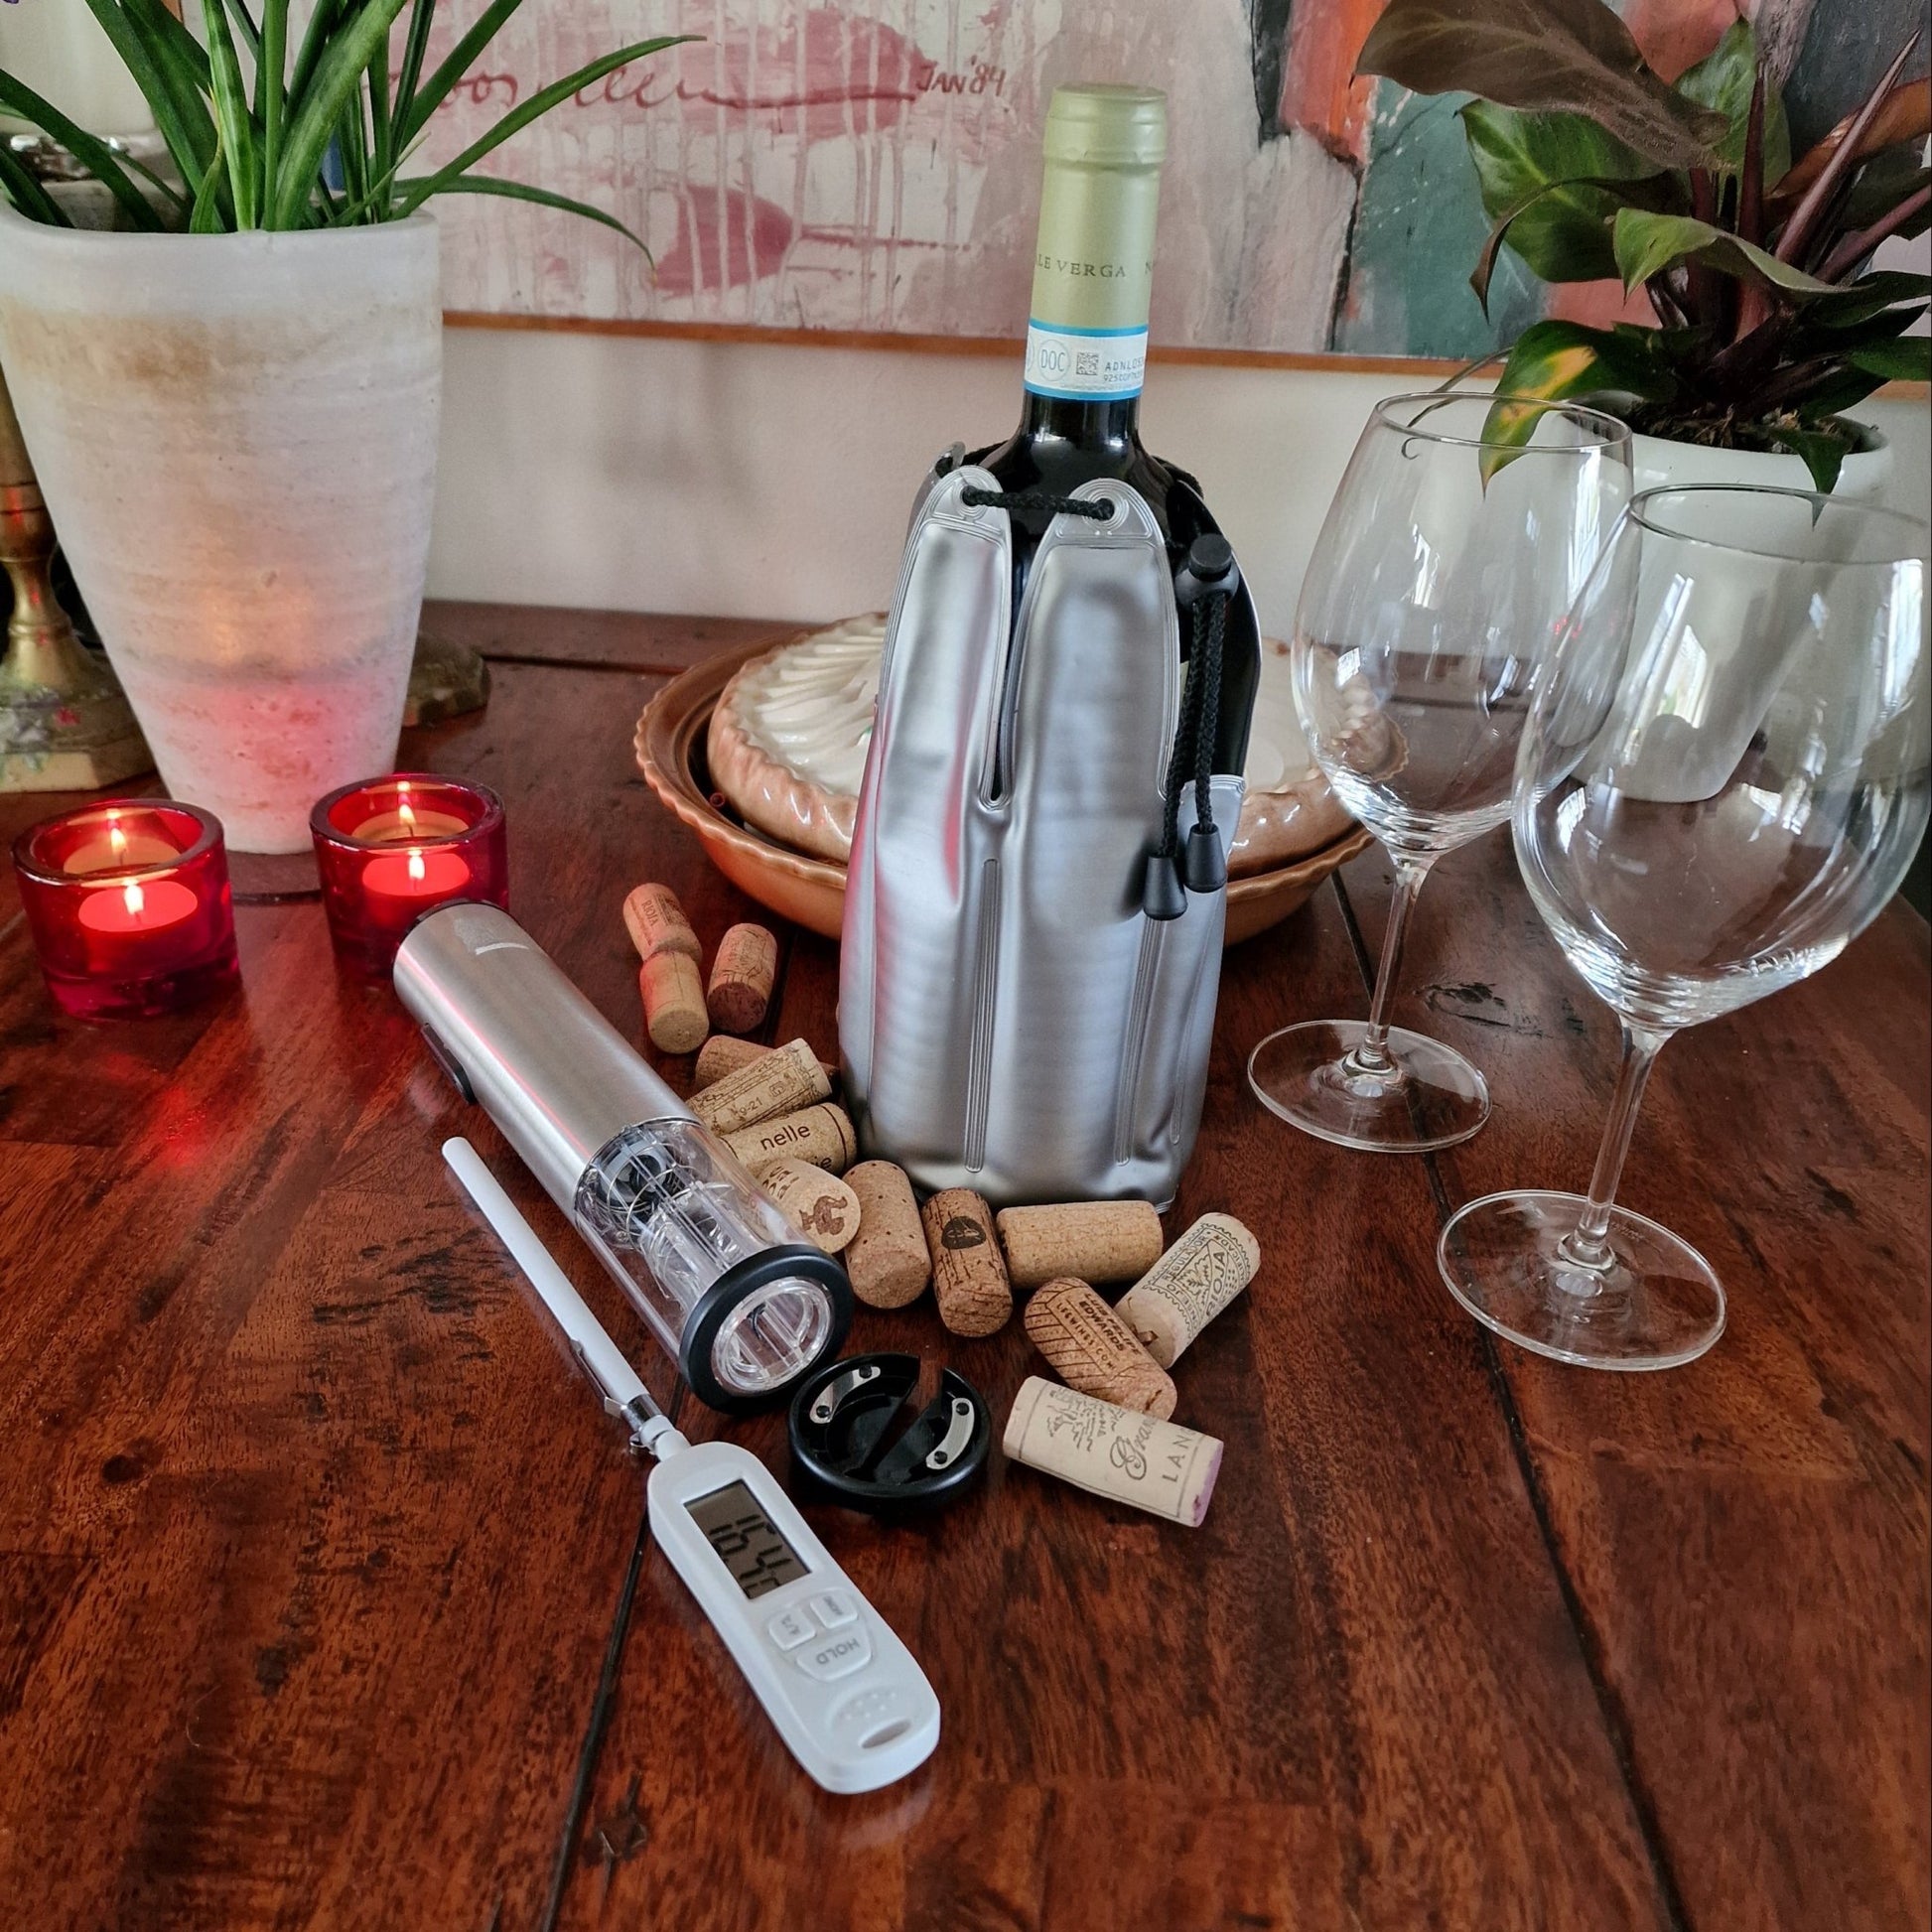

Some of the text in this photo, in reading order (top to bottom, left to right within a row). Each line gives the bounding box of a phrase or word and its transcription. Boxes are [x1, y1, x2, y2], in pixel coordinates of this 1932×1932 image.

[1056, 259, 1127, 278] VERGA
[1040, 348, 1066, 372] DOC
[641, 899, 659, 926] RIOJA
[759, 1124, 811, 1151] nelle
[1205, 1251, 1226, 1316] RIOJA
[1078, 1300, 1125, 1352] EDWARDS
[1084, 1292, 1143, 1357] LUIS FELIPE
[814, 1637, 862, 1666] HOLD
